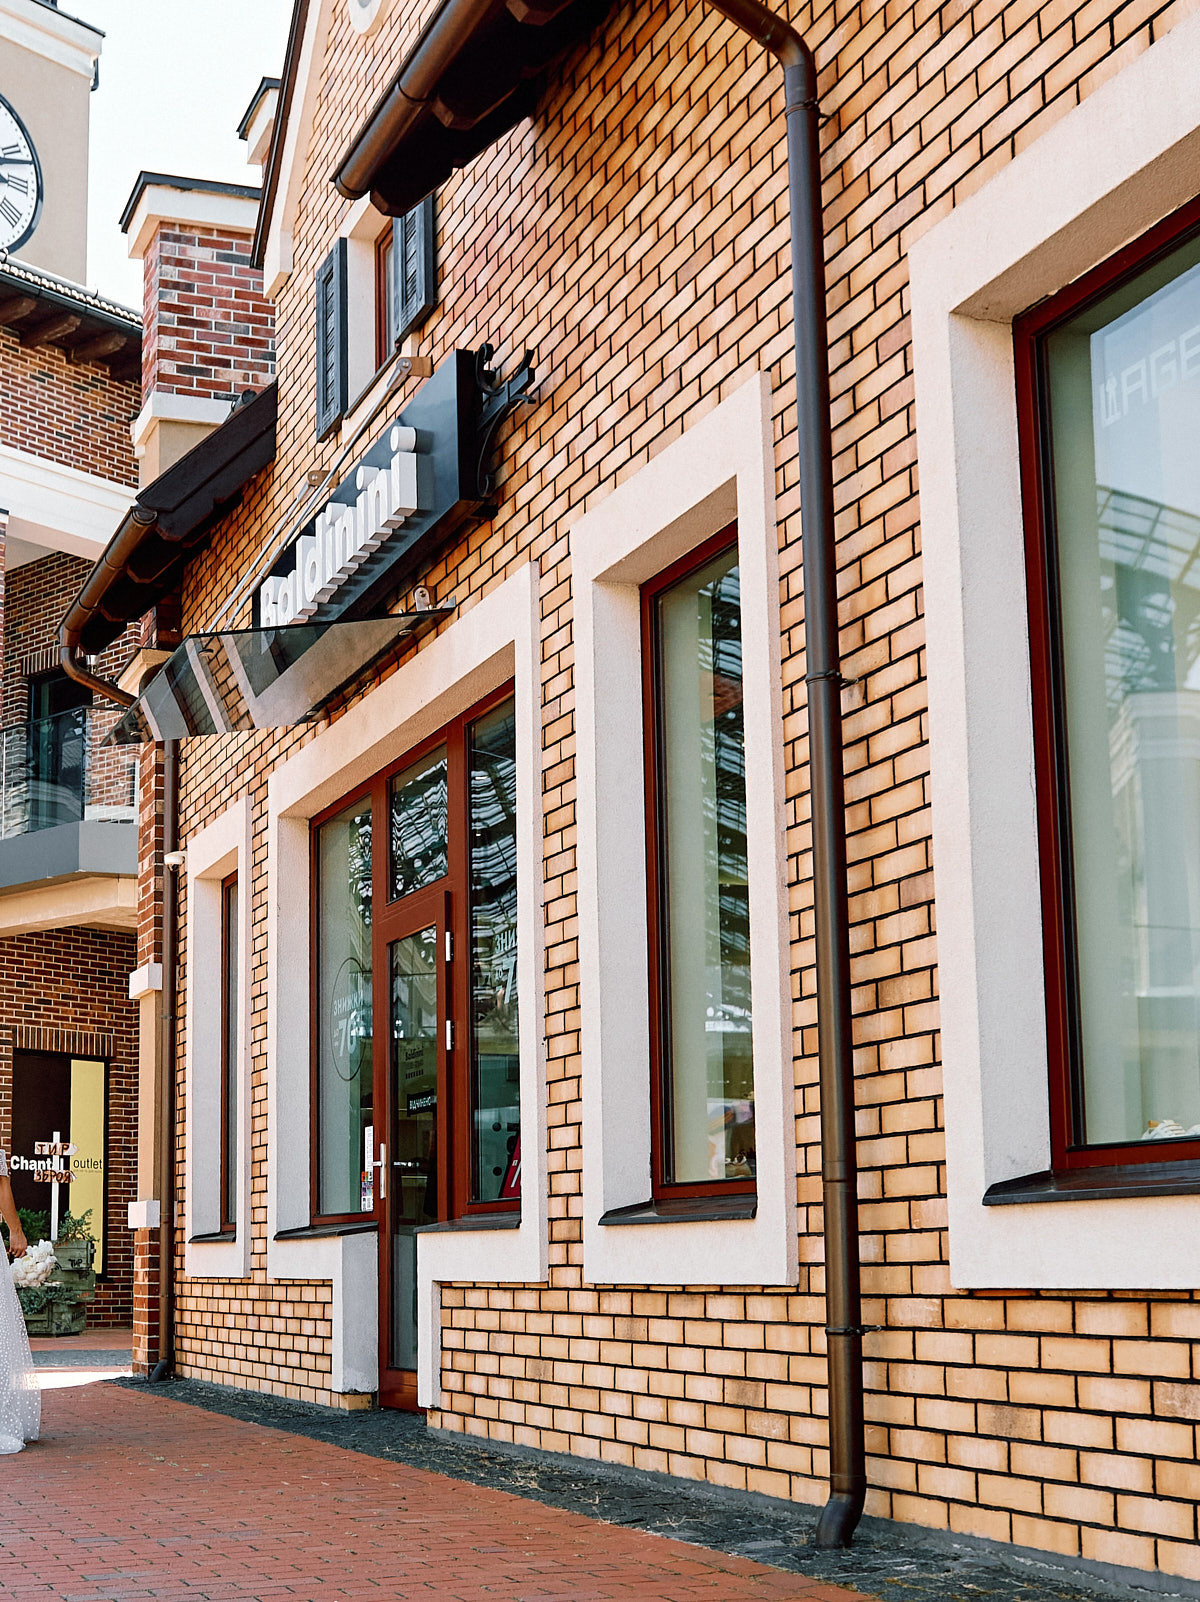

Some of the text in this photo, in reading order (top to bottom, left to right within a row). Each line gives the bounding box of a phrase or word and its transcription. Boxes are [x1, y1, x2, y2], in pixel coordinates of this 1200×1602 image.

[260, 426, 418, 654] Baldinini
[495, 927, 517, 953] ЗНИ
[37, 1144, 70, 1156] ТИР
[10, 1155, 102, 1170] Chantl outlet
